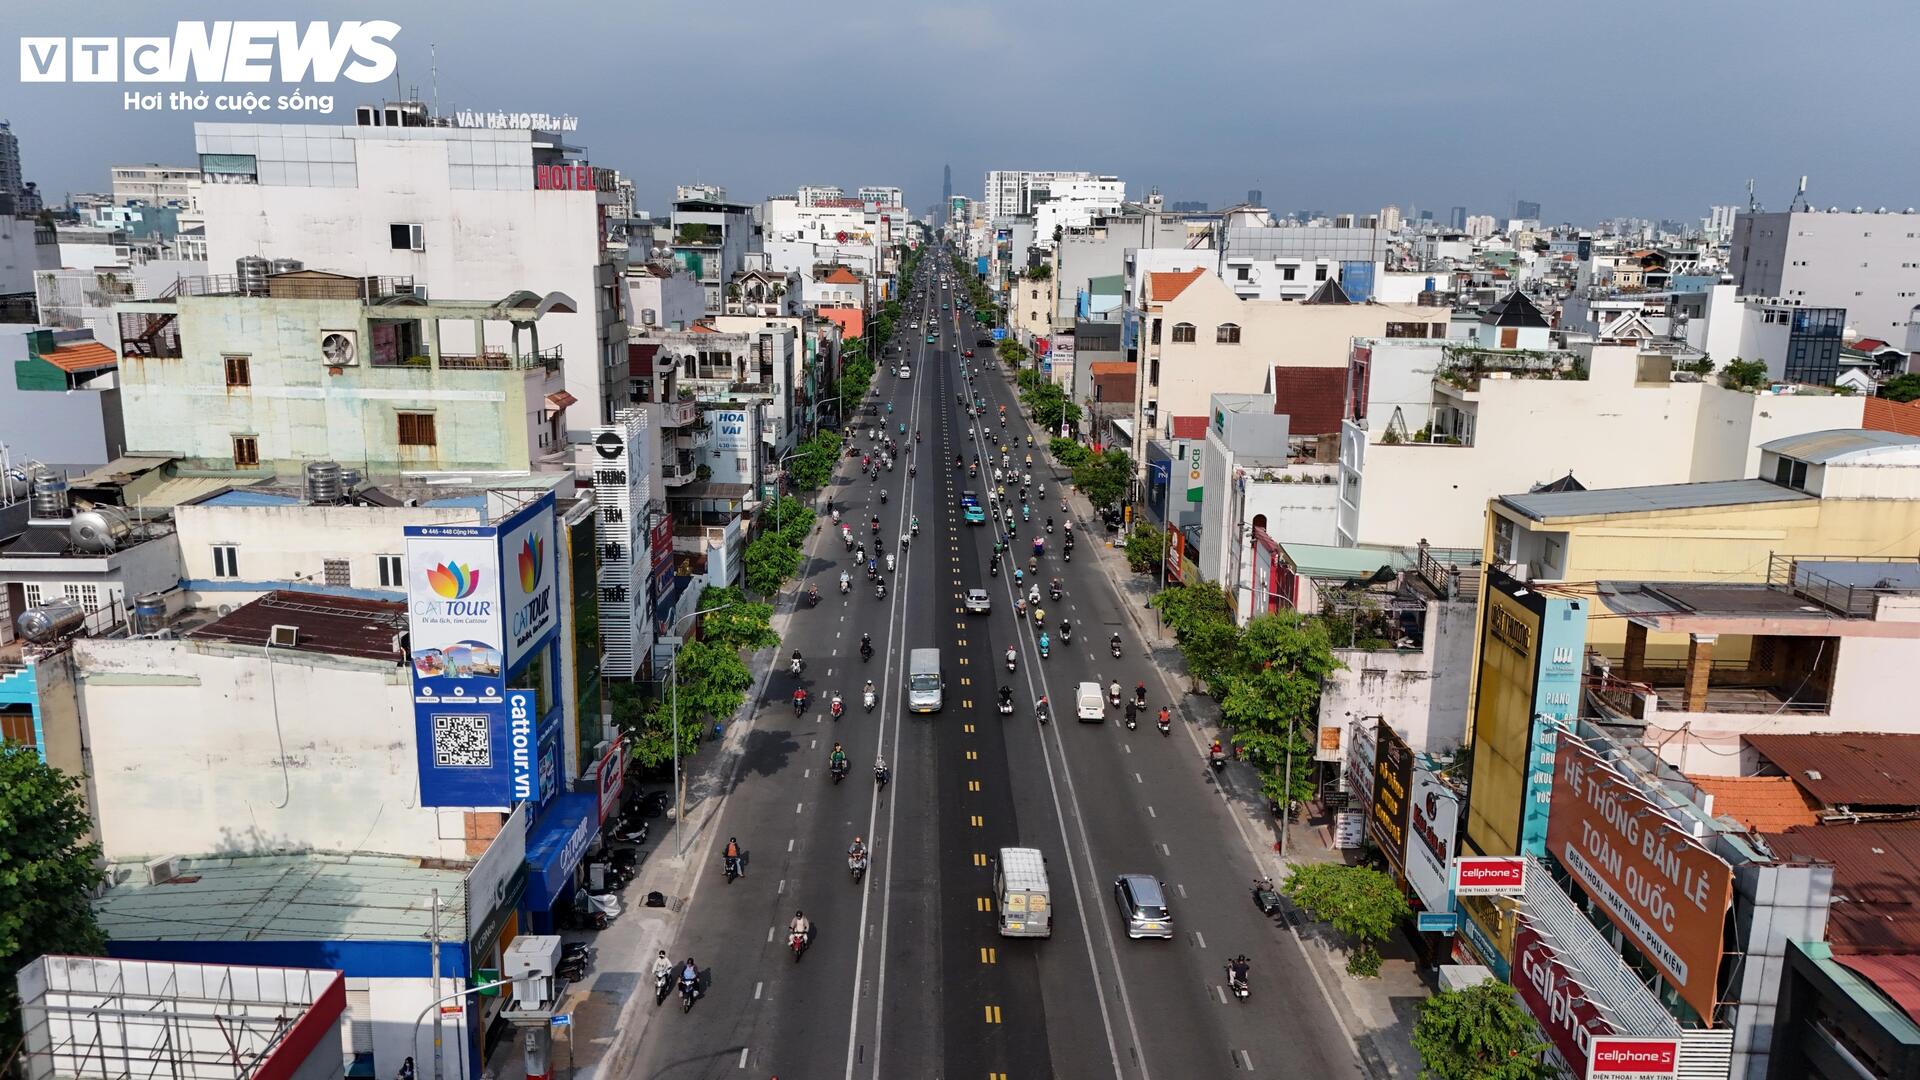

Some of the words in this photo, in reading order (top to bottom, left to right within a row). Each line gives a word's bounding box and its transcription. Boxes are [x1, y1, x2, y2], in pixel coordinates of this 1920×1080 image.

[537, 165, 596, 191] HOTEL
[718, 413, 744, 422] HOA
[1191, 448, 1201, 470] OCB
[595, 470, 626, 485] TRUNG
[603, 505, 623, 523] TÂM
[1545, 691, 1570, 706] PIANO
[510, 694, 531, 798] cattour.vn
[1540, 733, 1558, 745] GUIT
[1540, 752, 1555, 765] DRU
[1534, 772, 1553, 784] UKUL
[1536, 791, 1551, 804] VOC
[1563, 755, 1585, 798] HỆ
[1587, 777, 1640, 843] THỐNG
[1642, 831, 1681, 886] BÁN
[1684, 866, 1710, 913] LẺ
[1582, 819, 1622, 881] TOÀN
[1625, 864, 1676, 933] QUỐC
[1569, 851, 1584, 873] ĐIỆN
[1584, 866, 1604, 892] THOẠI
[1608, 891, 1623, 914] MÁY
[1623, 906, 1641, 932] TÍNH
[1646, 930, 1662, 955] PHỤ
[1663, 948, 1683, 977] KIỆN
[1522, 950, 1591, 1058] cellpho
